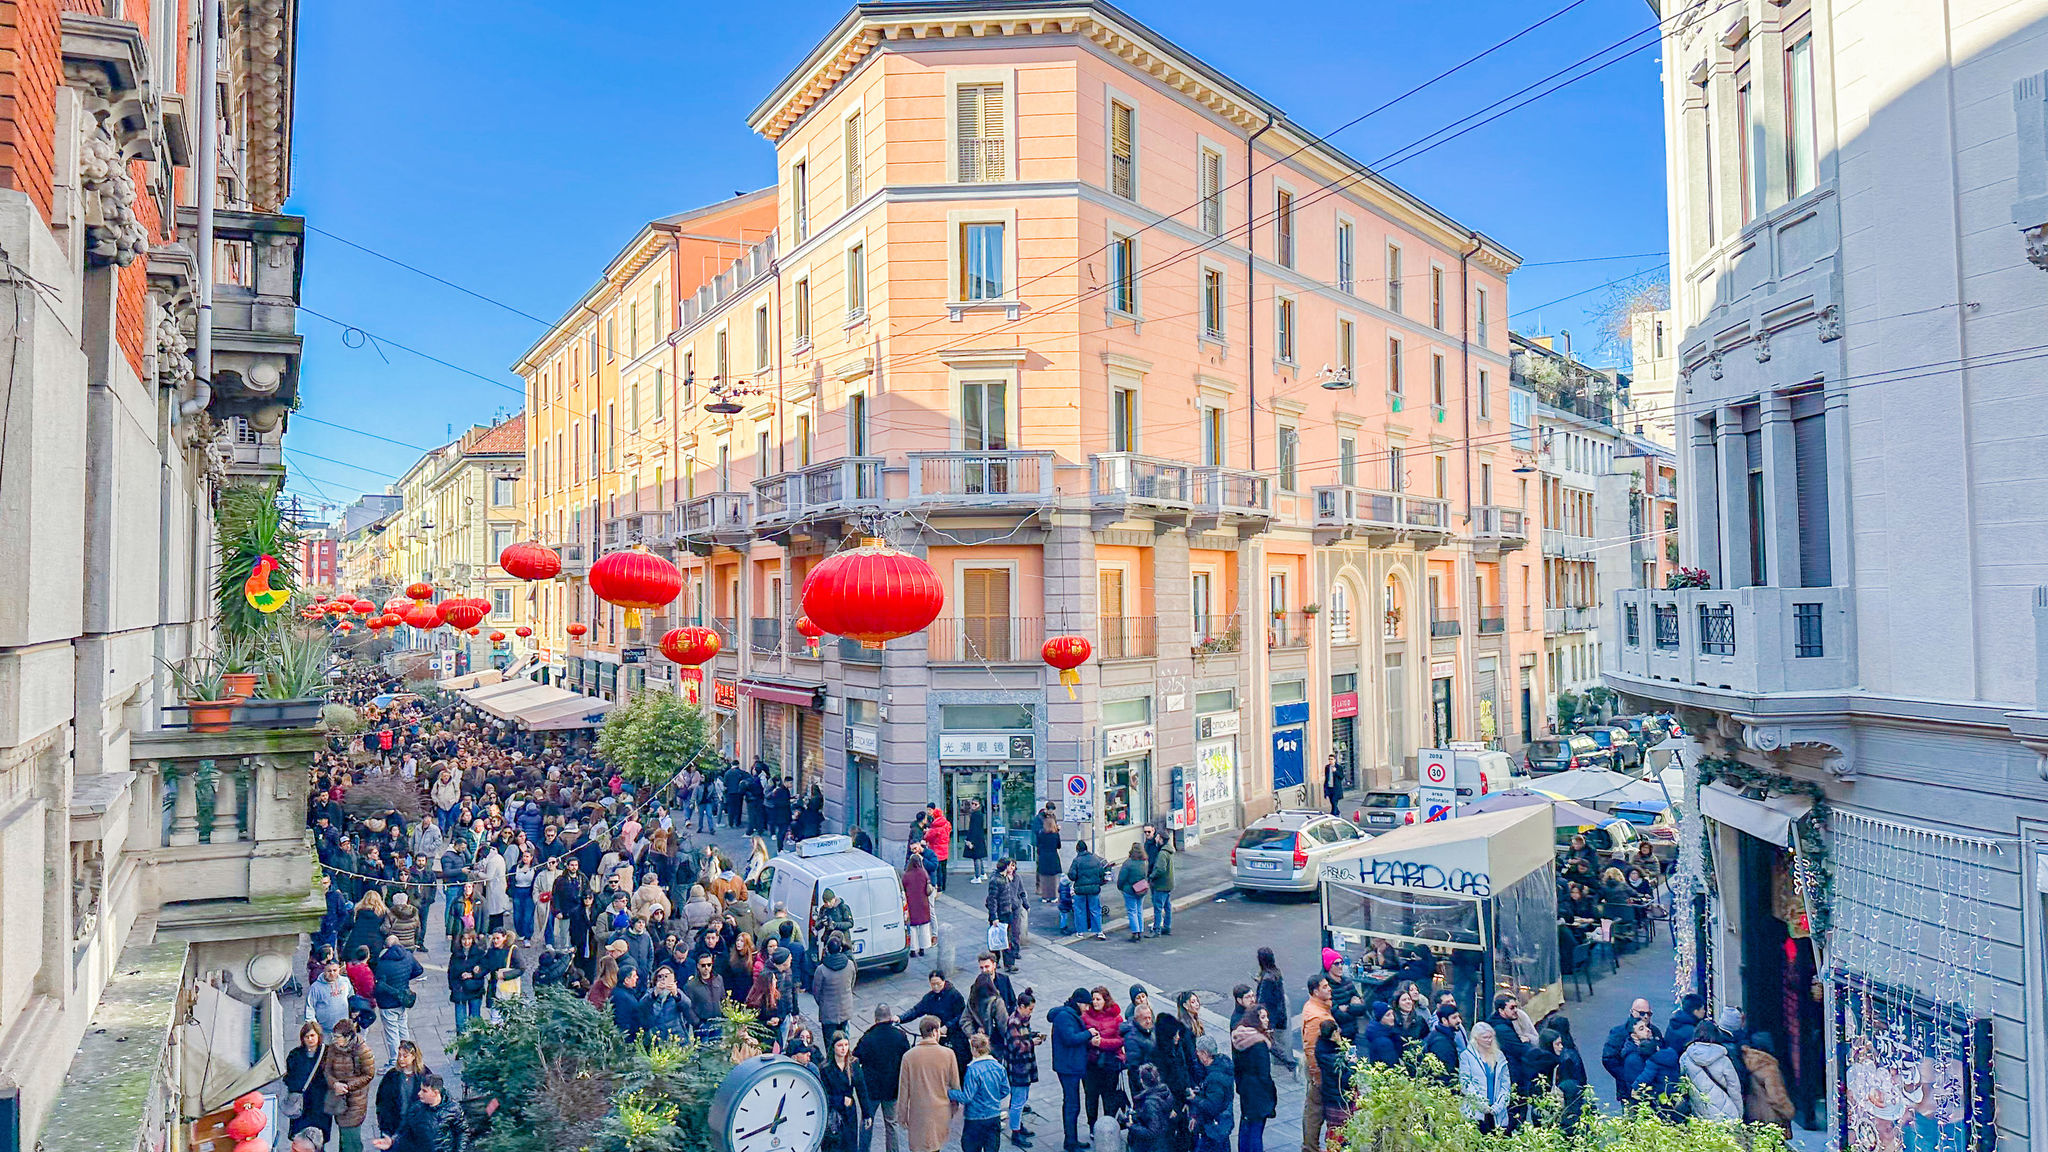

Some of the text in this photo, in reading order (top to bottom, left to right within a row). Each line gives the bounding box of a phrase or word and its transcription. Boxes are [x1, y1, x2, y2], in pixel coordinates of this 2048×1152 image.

[944, 741, 1005, 753] 光潮眼镜
[1431, 768, 1442, 777] 30
